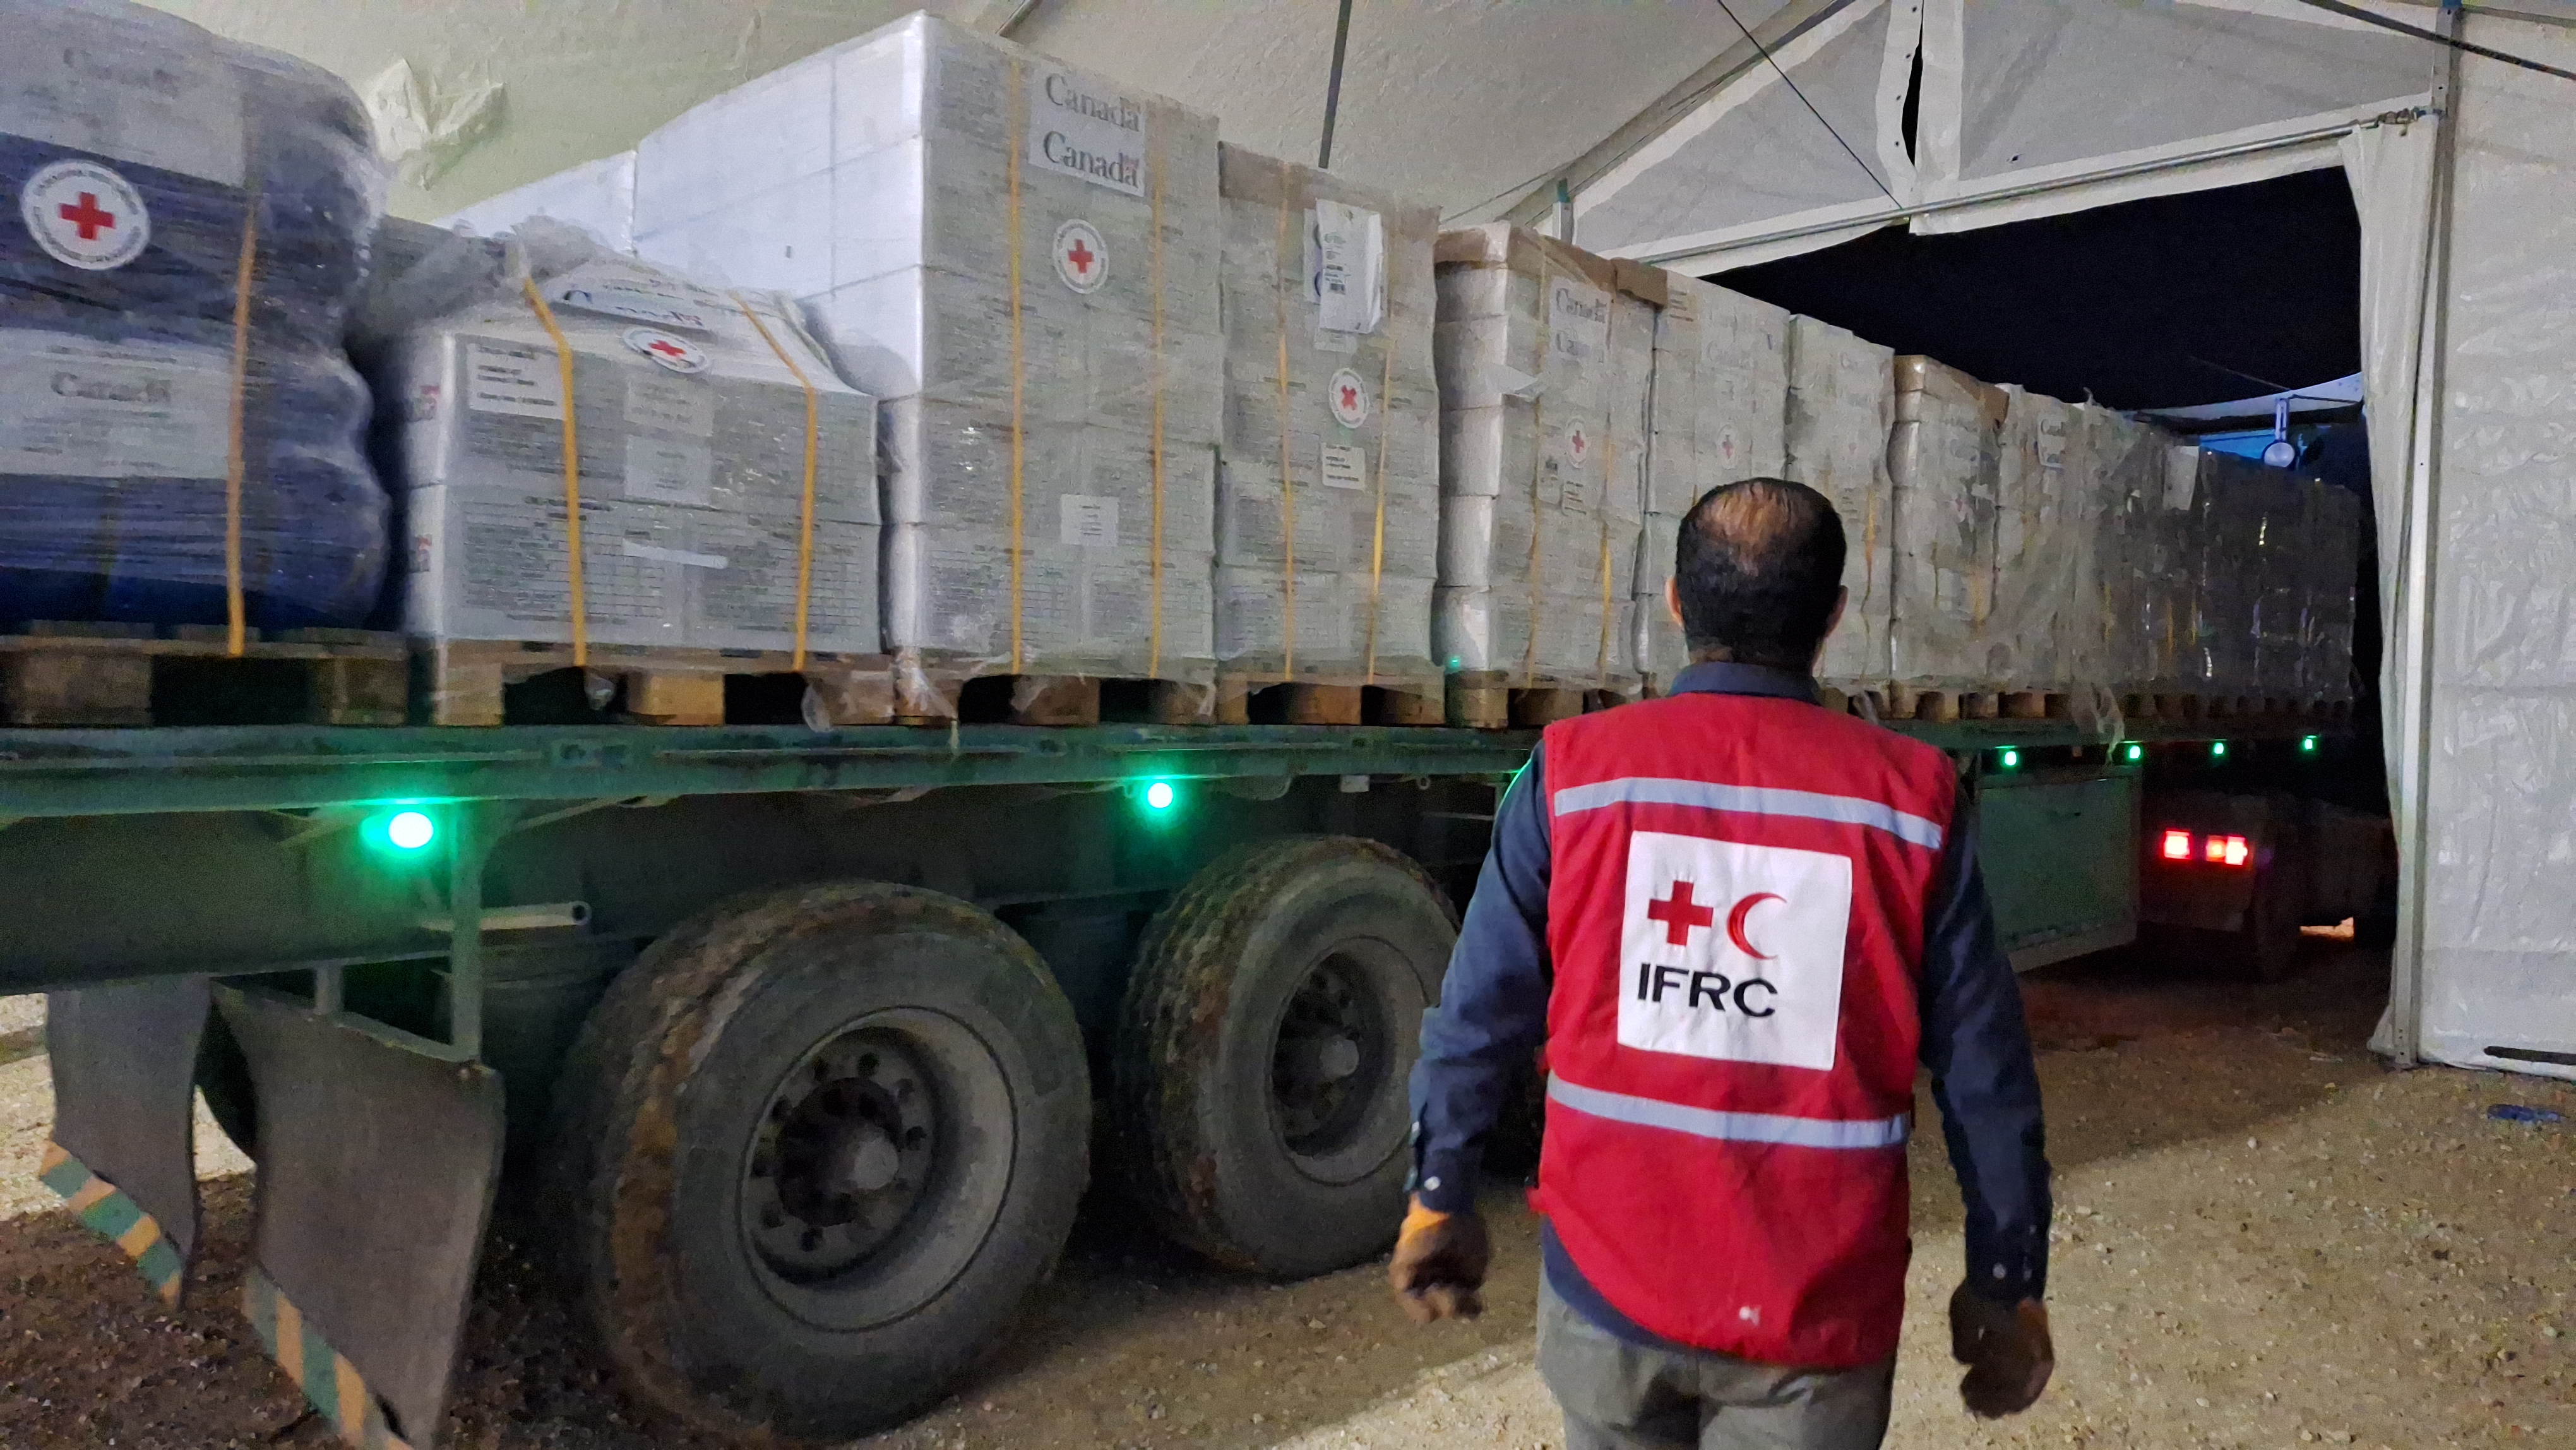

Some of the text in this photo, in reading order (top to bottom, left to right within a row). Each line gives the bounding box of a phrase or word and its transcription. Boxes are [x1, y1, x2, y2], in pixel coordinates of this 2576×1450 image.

[1046, 73, 1139, 132] Canada
[1043, 131, 1138, 189] Canada
[1637, 963, 1778, 1017] IFRC
